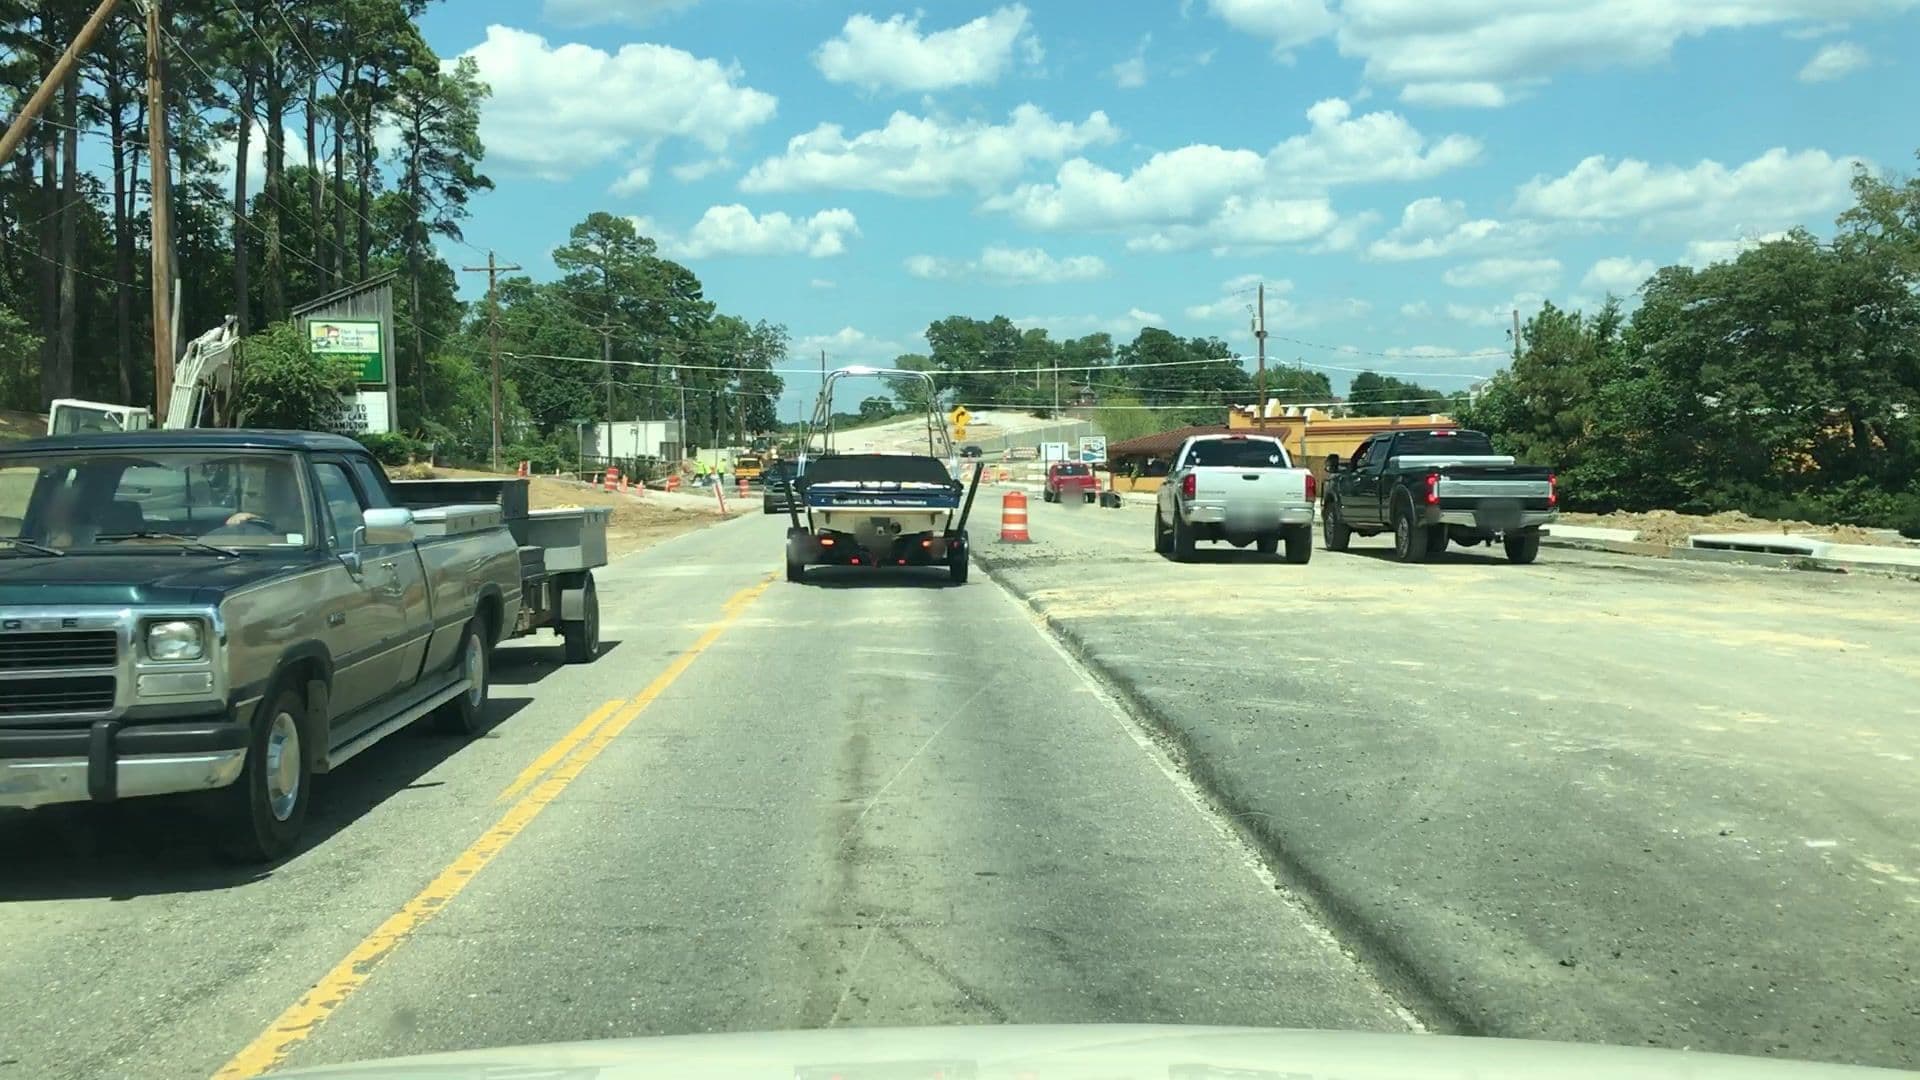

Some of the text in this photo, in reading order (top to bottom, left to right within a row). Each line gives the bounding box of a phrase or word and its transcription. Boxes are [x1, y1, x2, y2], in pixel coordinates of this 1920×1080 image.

[356, 403, 367, 412] TO
[347, 412, 368, 421] LAKE
[328, 421, 369, 430] HAMILTON
